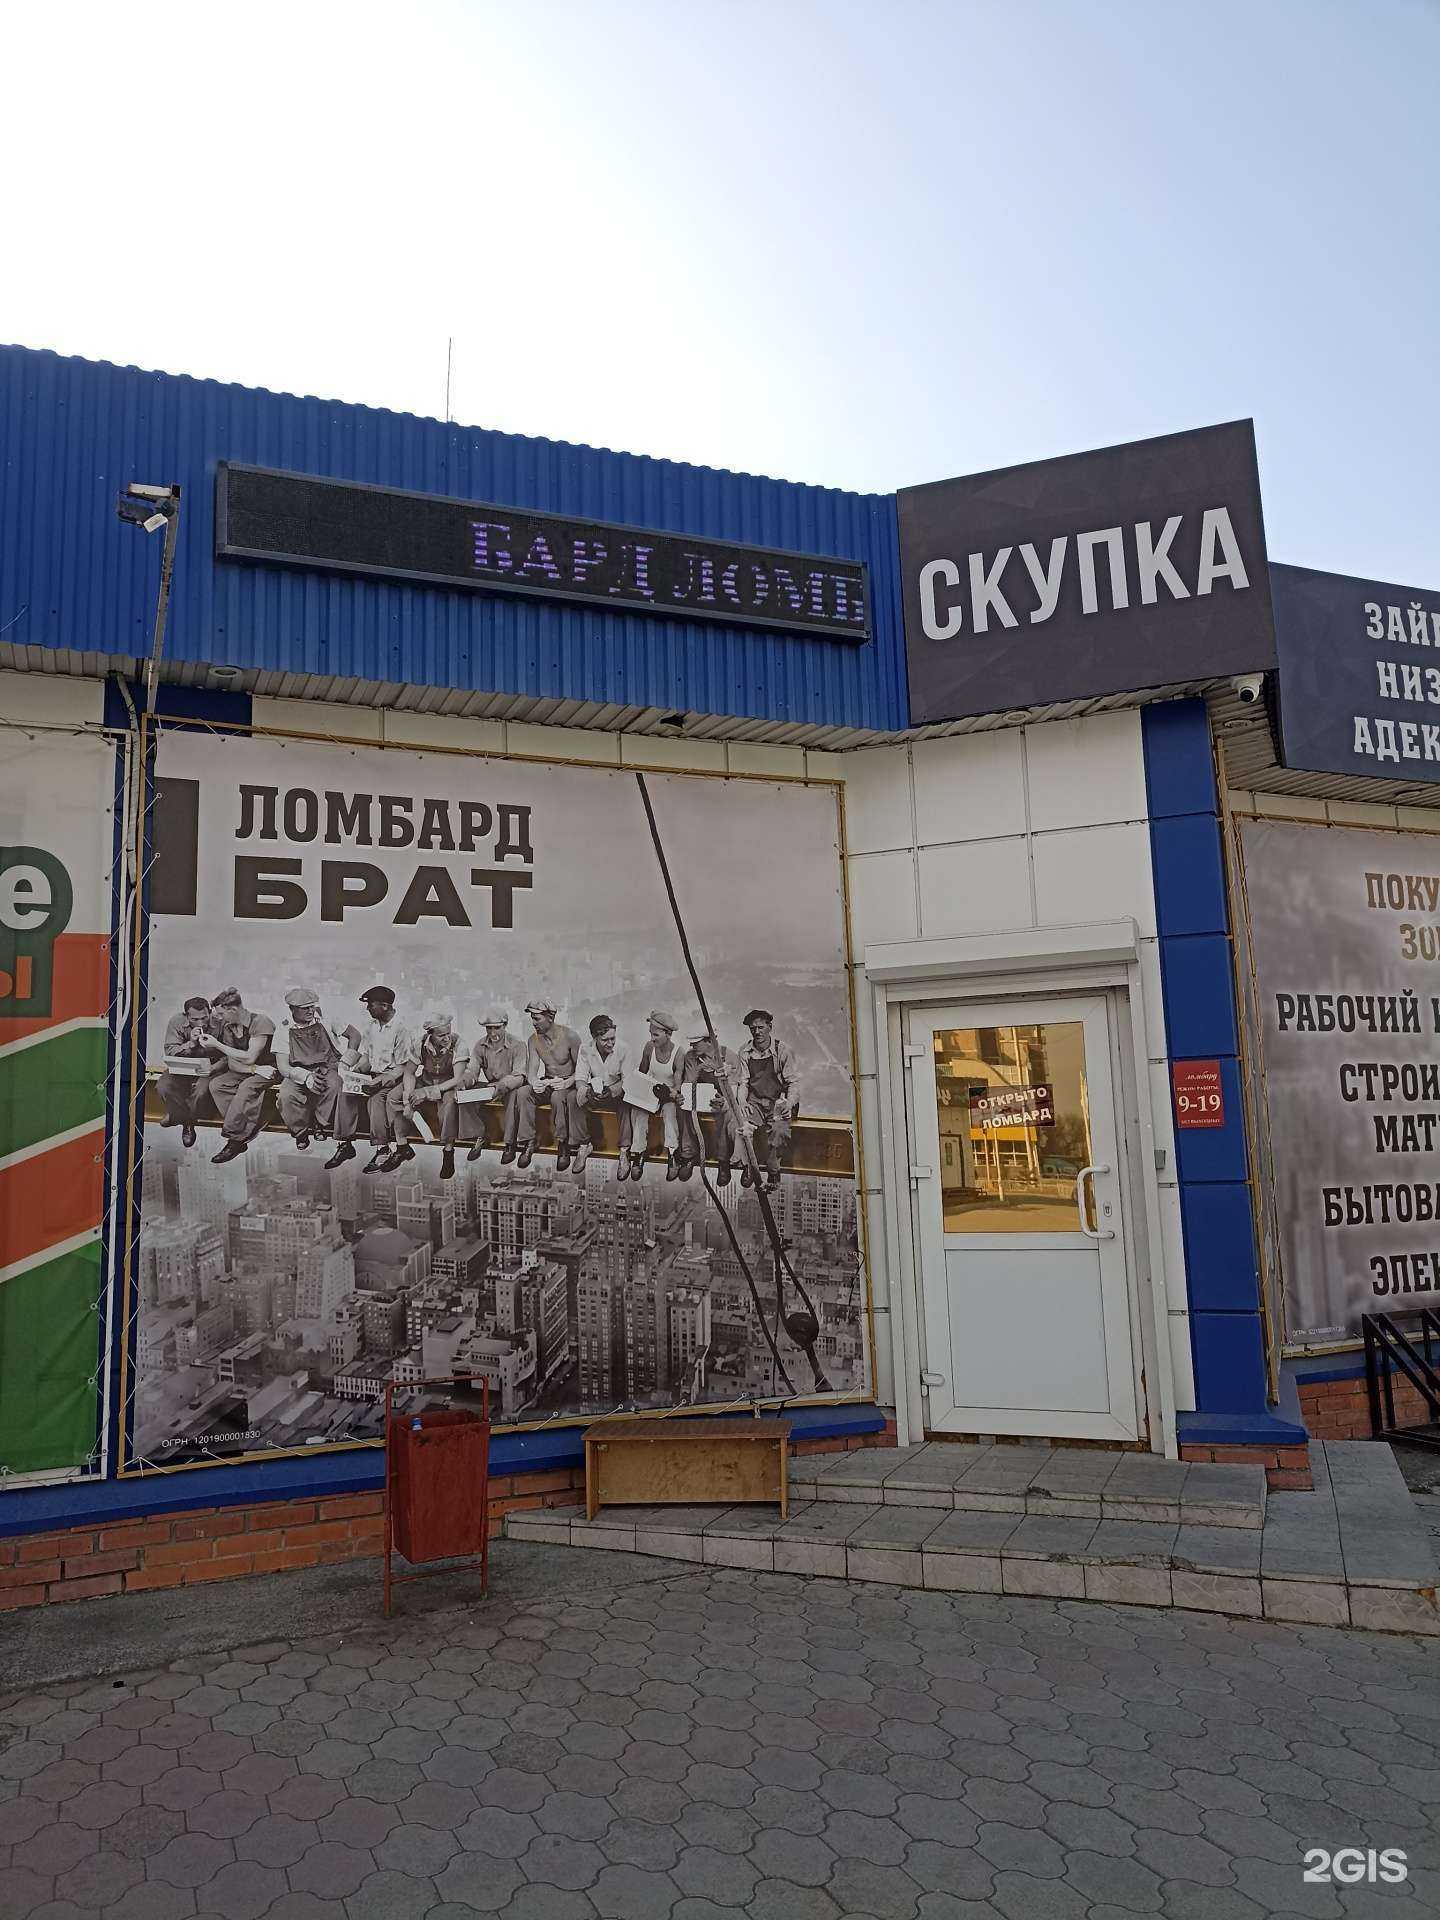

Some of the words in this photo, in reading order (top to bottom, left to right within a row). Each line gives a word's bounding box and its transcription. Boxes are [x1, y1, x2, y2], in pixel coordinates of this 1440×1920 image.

[919, 506, 1250, 640] СКУПКА
[235, 784, 534, 864] ЛОМБАРД
[233, 855, 533, 929] БРАТ
[1365, 872, 1440, 912] ПОКУ
[1400, 923, 1440, 961] ЗО
[1275, 988, 1421, 1033] РАБОЧИЙ
[978, 1087, 1047, 1110] ОТКРЫТО
[1340, 1063, 1440, 1102] СТРОИ
[982, 1107, 1052, 1129] ЛОМБАРД
[1178, 1094, 1221, 1112] 9-19
[1374, 1113, 1440, 1153] МАТ
